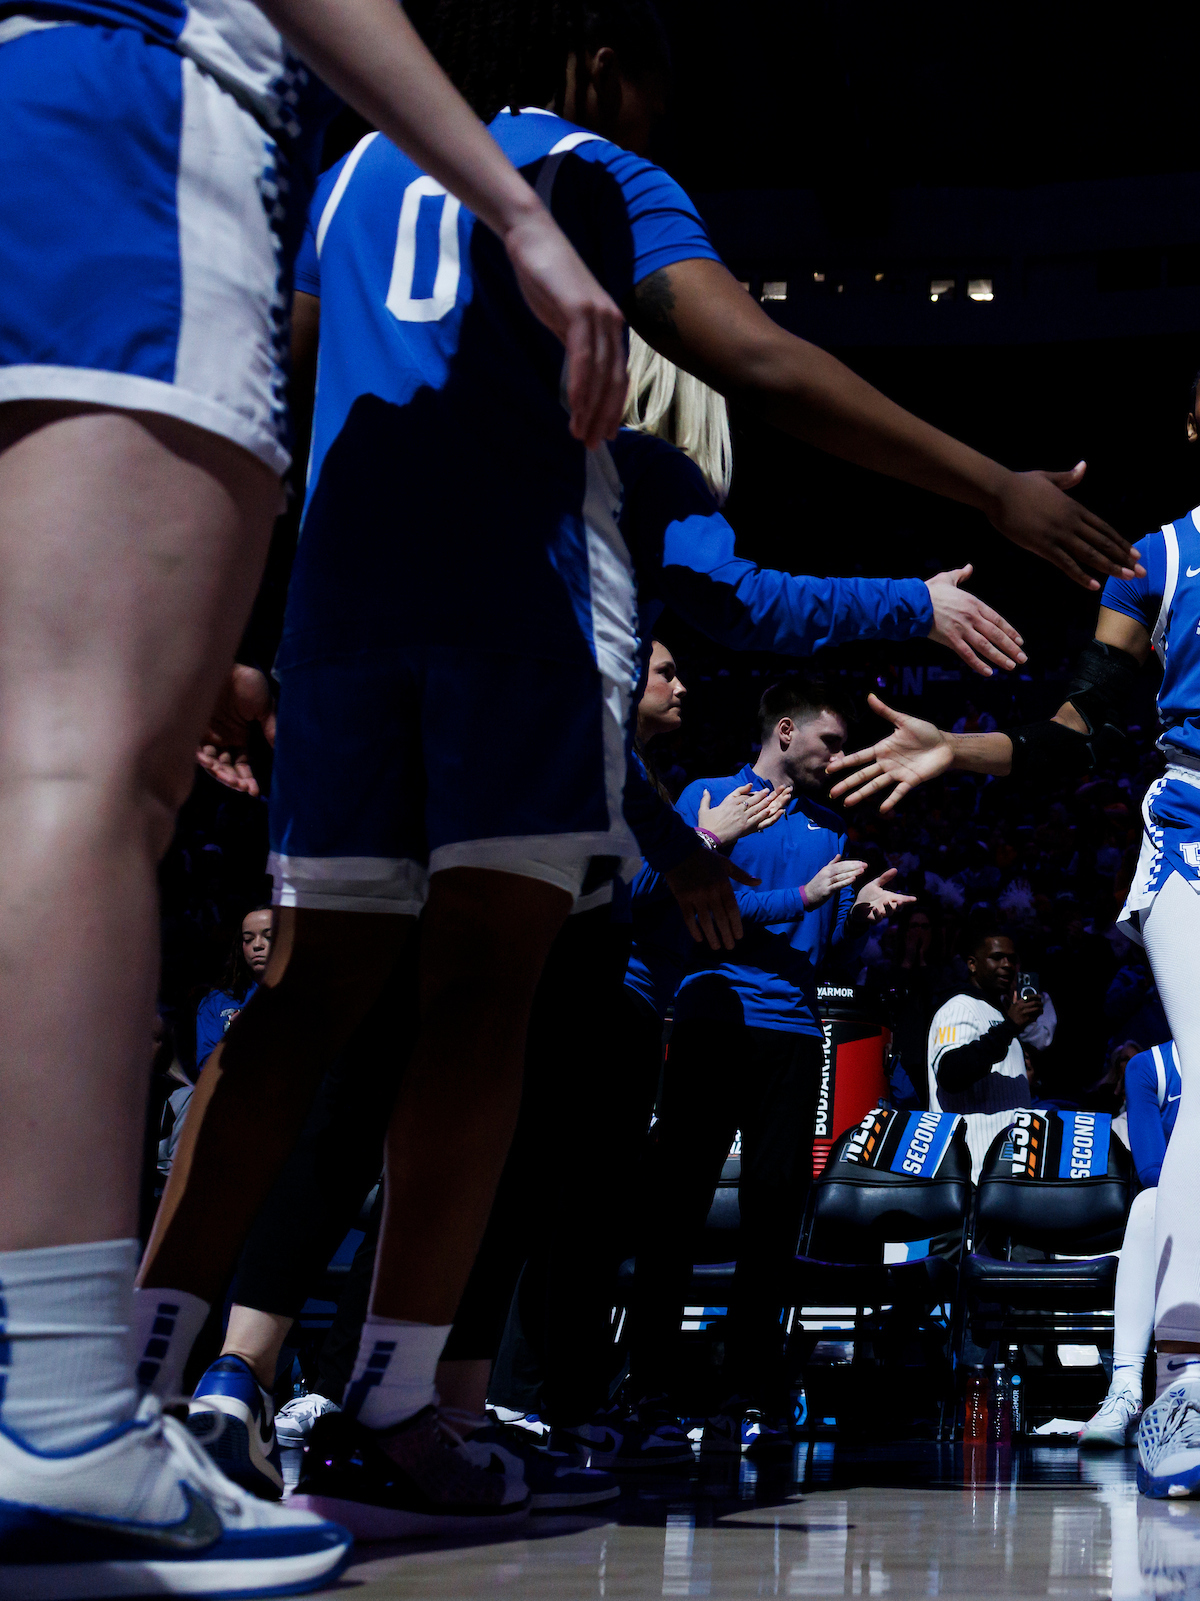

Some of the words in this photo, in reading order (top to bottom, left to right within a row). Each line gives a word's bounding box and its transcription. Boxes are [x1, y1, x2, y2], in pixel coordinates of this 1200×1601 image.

[385, 175, 461, 322] 0
[902, 1112, 942, 1175] SECOND
[1069, 1115, 1096, 1179] SECOND
